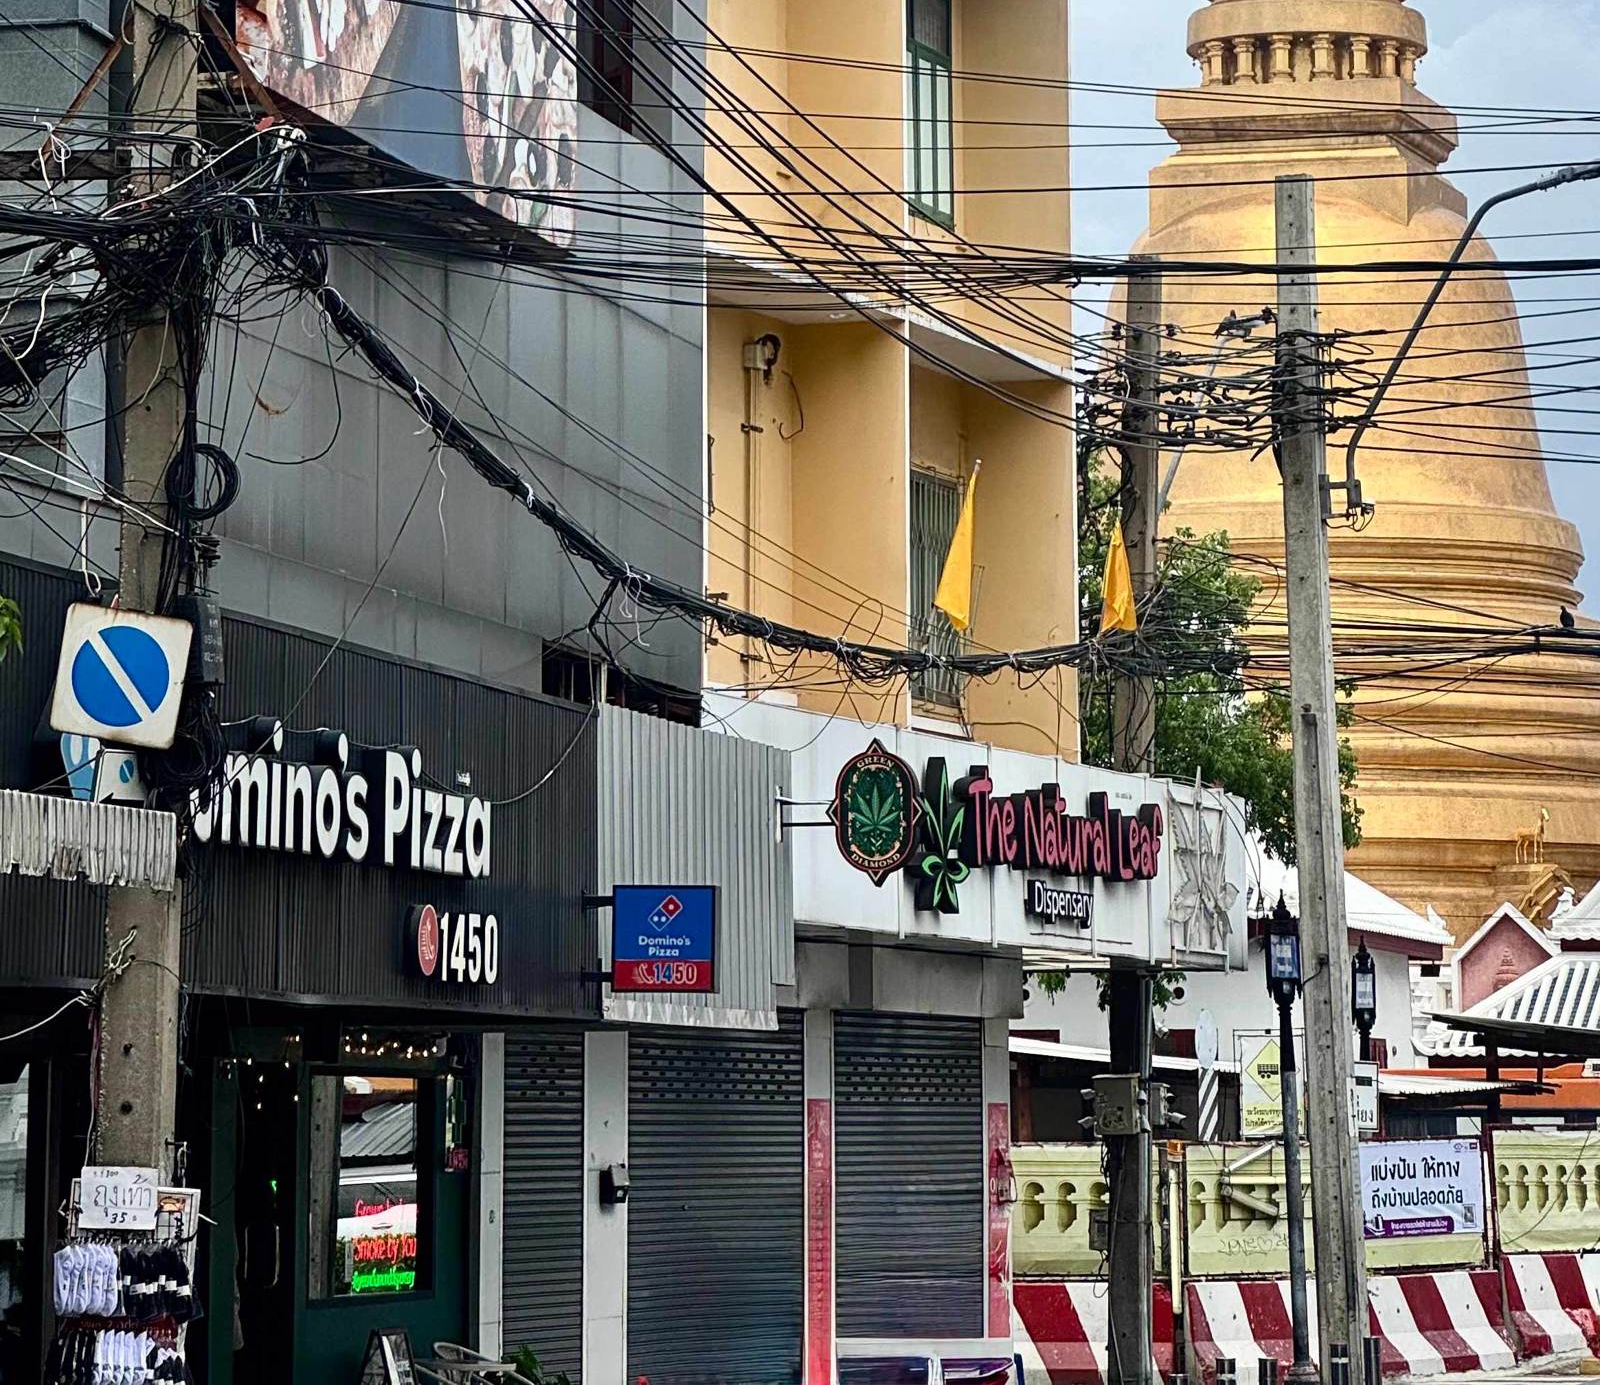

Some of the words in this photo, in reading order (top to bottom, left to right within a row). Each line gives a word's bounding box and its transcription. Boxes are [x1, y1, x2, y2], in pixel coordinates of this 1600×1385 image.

[857, 756, 894, 768] GREEN
[188, 719, 370, 863] omino's
[384, 748, 492, 878] Pizza
[968, 768, 1018, 865] The
[1024, 786, 1111, 877] Natural
[1118, 804, 1163, 881] Leaf
[851, 853, 900, 867] DIAMOND
[1034, 881, 1093, 926] Dispensary
[440, 912, 498, 984] 1450
[638, 935, 691, 946] Domino's
[648, 947, 680, 957] Pizza
[653, 962, 697, 985] 1450
[1371, 1156, 1417, 1181] แบ่งปัน
[1421, 1156, 1460, 1178] ให้ทาง
[1371, 1184, 1464, 1208] ถึงบ้านปลอดภัย
[355, 1236, 386, 1261] Smoke
